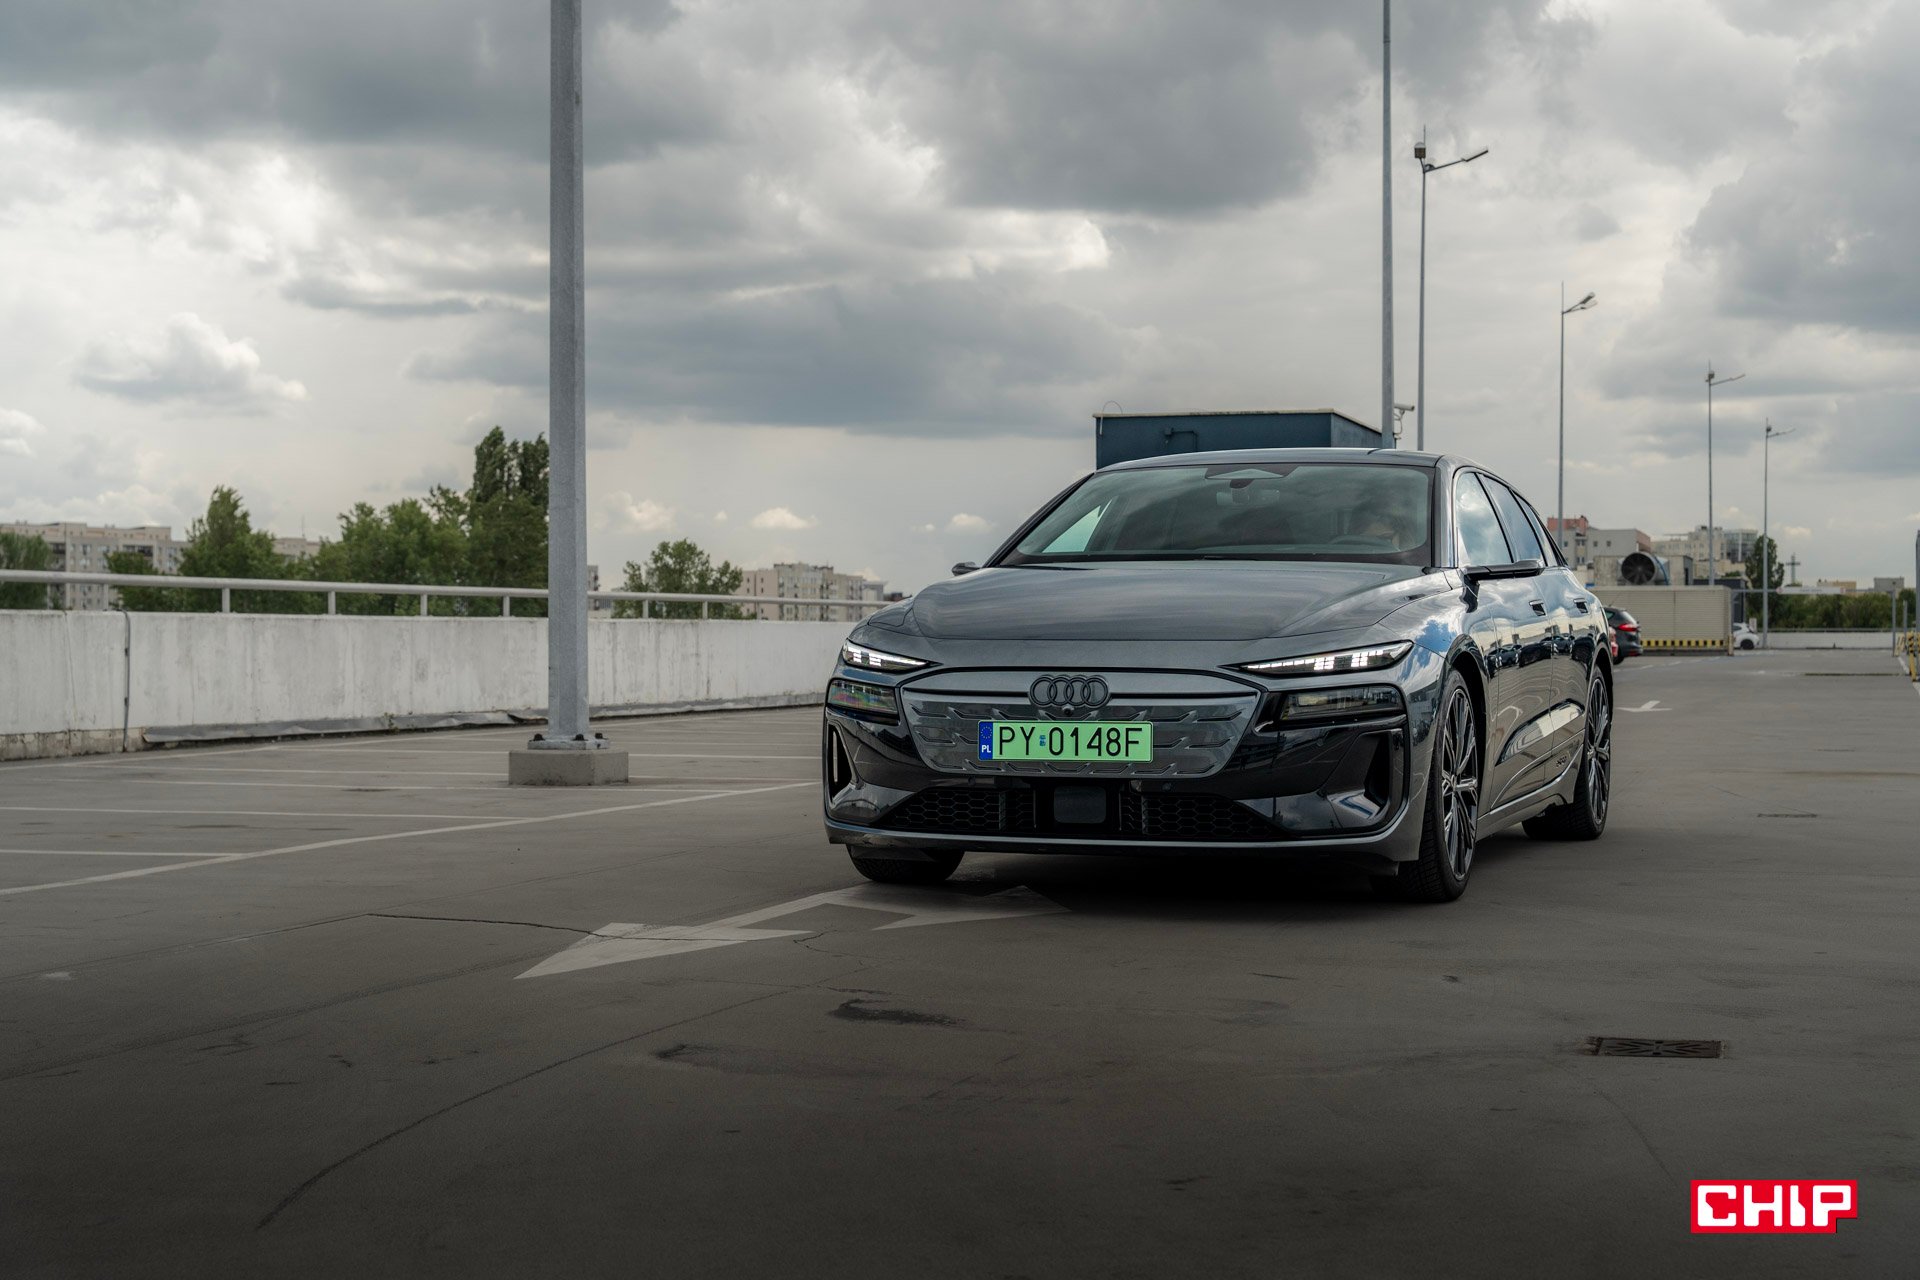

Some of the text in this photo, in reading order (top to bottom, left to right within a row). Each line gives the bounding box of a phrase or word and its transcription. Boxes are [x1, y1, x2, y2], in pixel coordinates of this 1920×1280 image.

[981, 744, 992, 753] PL
[999, 726, 1143, 757] PY 0148F
